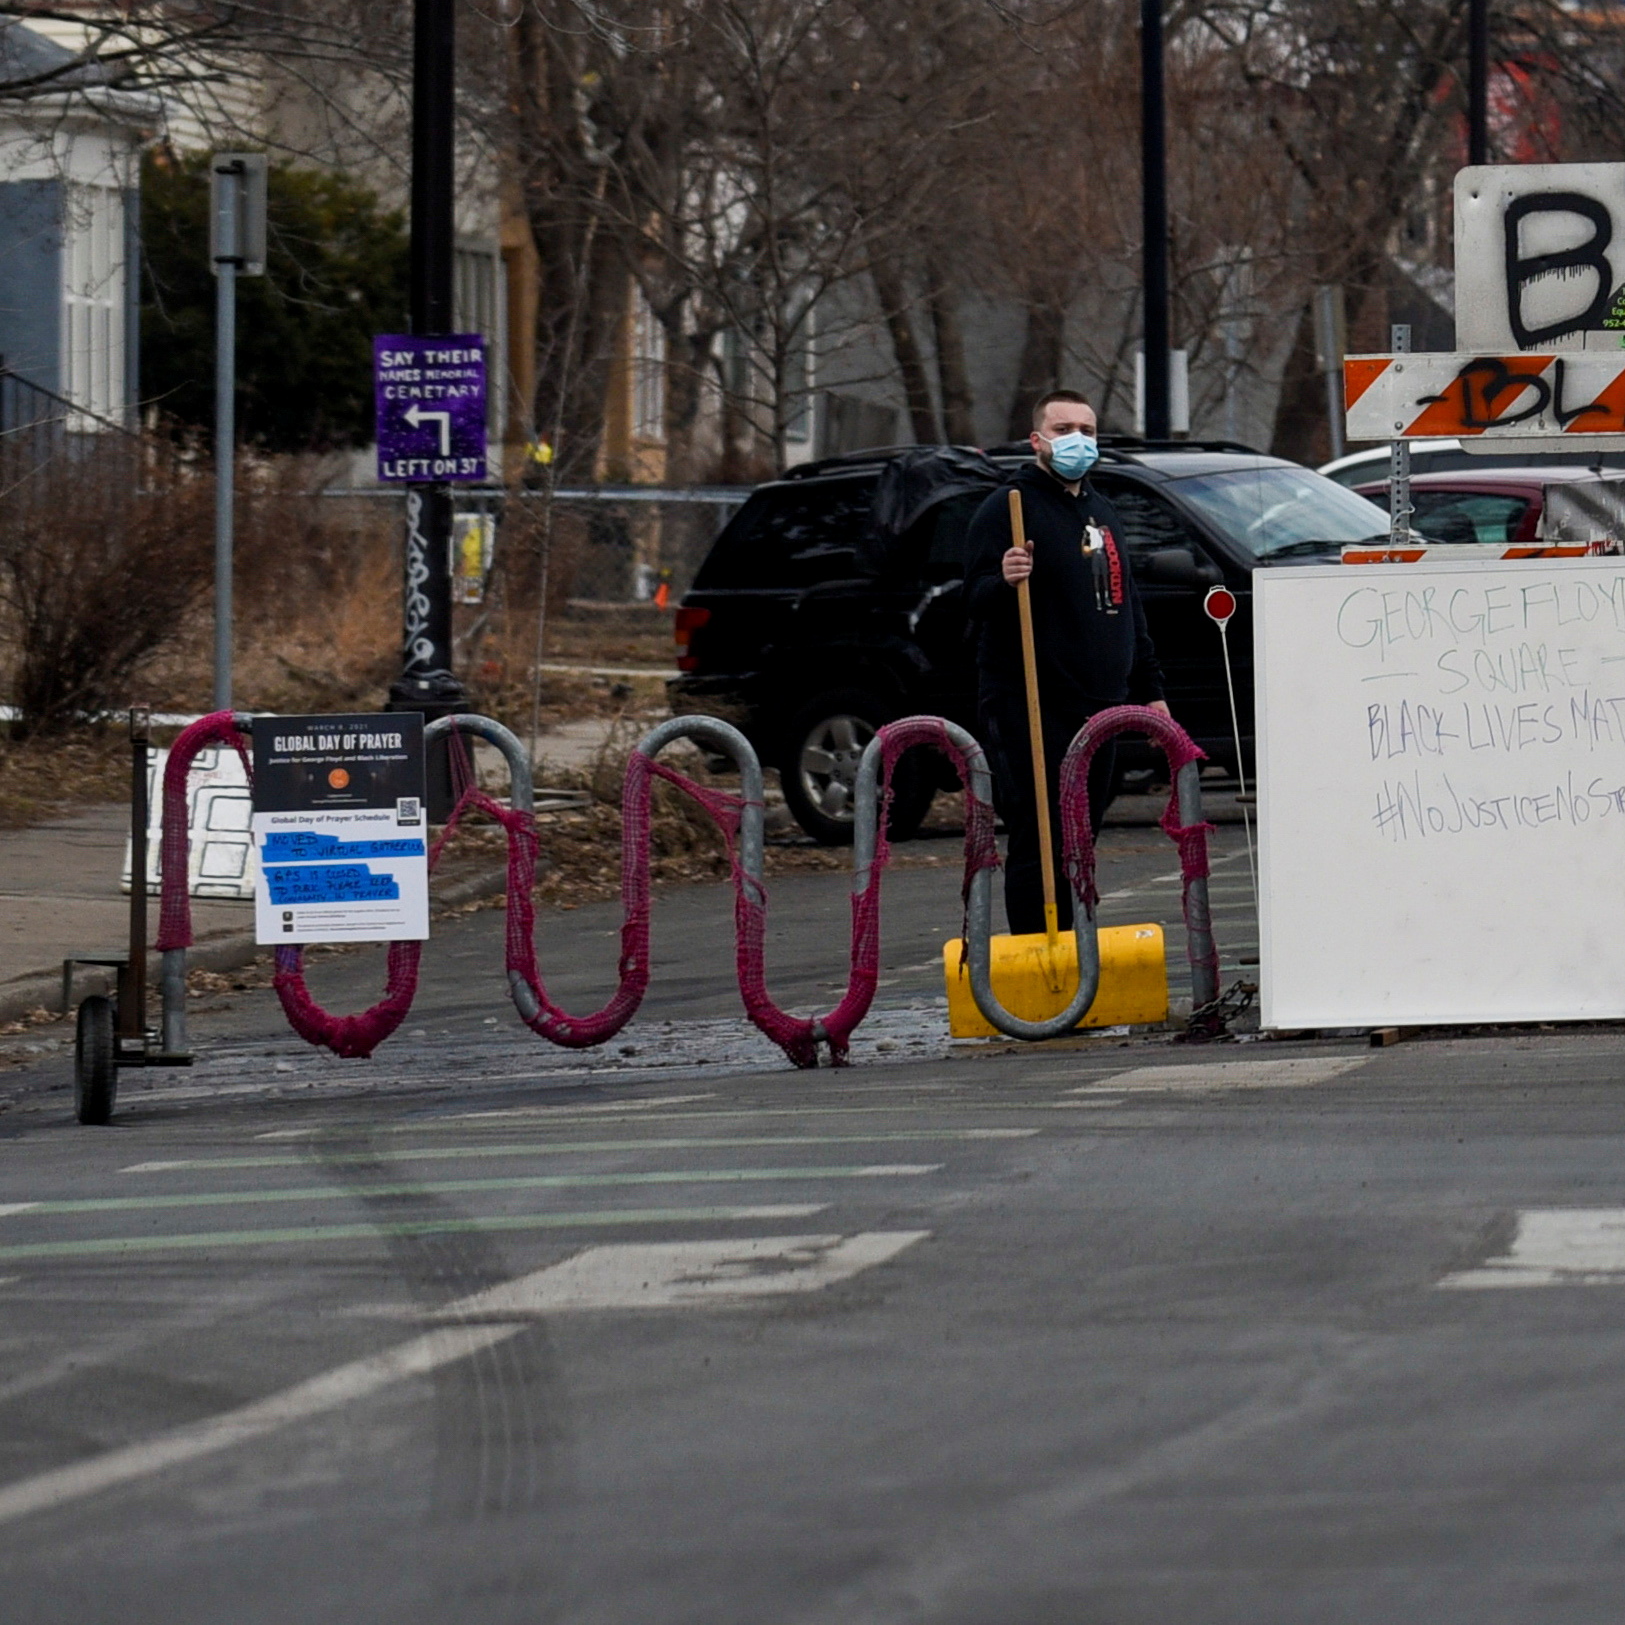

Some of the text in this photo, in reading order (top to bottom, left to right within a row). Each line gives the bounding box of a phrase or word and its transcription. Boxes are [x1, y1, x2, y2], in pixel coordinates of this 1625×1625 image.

[380, 348, 482, 367] SAY THEIR
[378, 368, 480, 382] NAMES MEMORIAL
[384, 385, 480, 399] CEMETARY
[383, 459, 430, 477] LEFT
[434, 458, 457, 475] ON
[1337, 585, 1514, 663] GEORGE
[1437, 642, 1592, 694] SQUARE
[1367, 698, 1460, 762] BLACK
[1463, 701, 1563, 753] LIVES
[274, 732, 402, 752] GLOBAL DAY OF PRAYER
[269, 757, 291, 765] Justice
[302, 756, 324, 764] George
[325, 755, 343, 764] Floyd
[375, 753, 409, 761] Liberation
[271, 813, 391, 824] Global Day of Prayer Schedule
[272, 834, 318, 846] MOVED
[291, 847, 307, 857] TO
[317, 844, 364, 857] VIRTUAL
